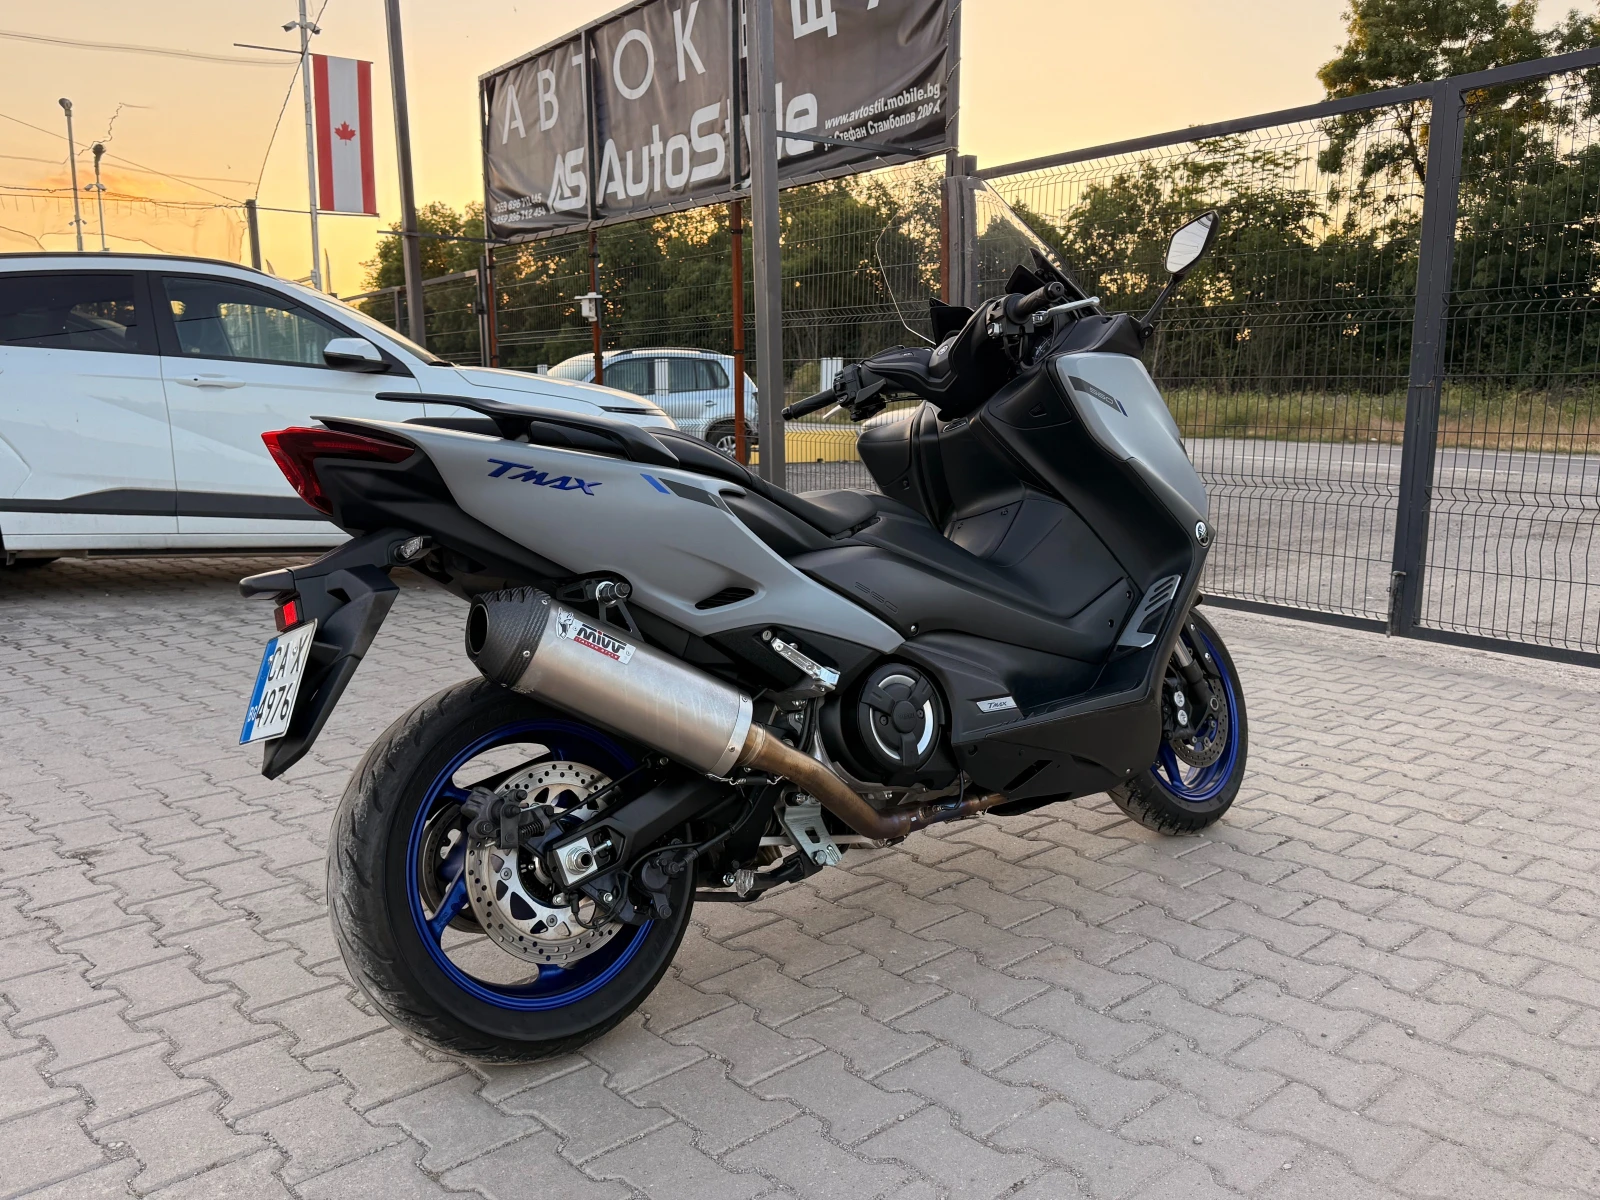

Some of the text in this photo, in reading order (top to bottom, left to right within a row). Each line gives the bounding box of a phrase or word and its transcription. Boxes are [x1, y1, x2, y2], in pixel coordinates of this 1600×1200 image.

[502, 0, 880, 144] АВТОКЩ
[825, 82, 941, 129] www.avtostil.mobile.bg
[867, 111, 916, 135] Стамболов
[487, 458, 602, 496] TMAX
[267, 643, 291, 682] CA
[256, 682, 294, 728] 4976
[987, 701, 1007, 709] TMAX
